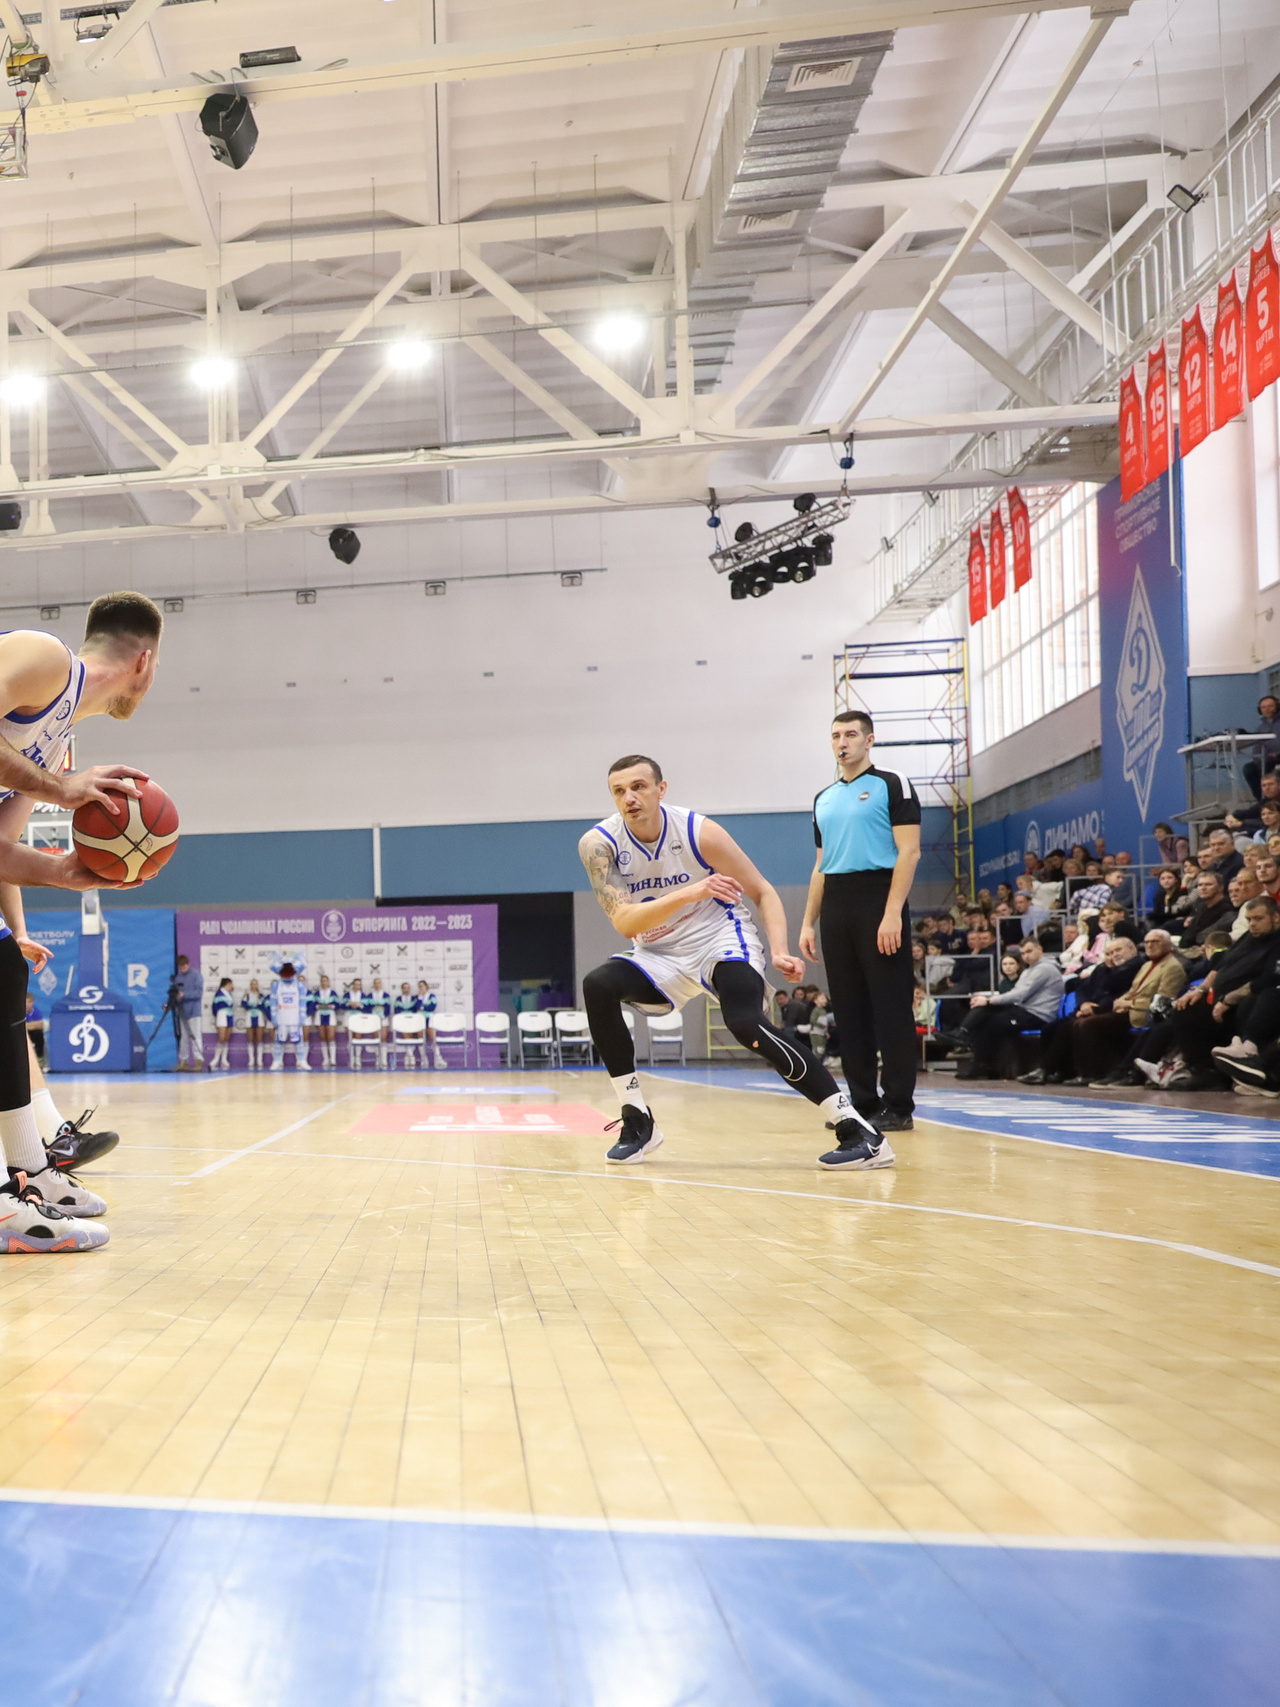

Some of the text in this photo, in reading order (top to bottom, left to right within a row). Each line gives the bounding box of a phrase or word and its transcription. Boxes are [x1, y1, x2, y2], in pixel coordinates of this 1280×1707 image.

[1257, 286, 1269, 330] 5
[1220, 318, 1237, 366] 14
[1184, 352, 1201, 396] 12
[1150, 384, 1165, 425] 15
[1125, 411, 1134, 444] 4
[1014, 516, 1025, 547] 10
[971, 556, 982, 585] 15
[1044, 811, 1100, 857] ДИНАМО
[627, 873, 690, 893] ИНАМО
